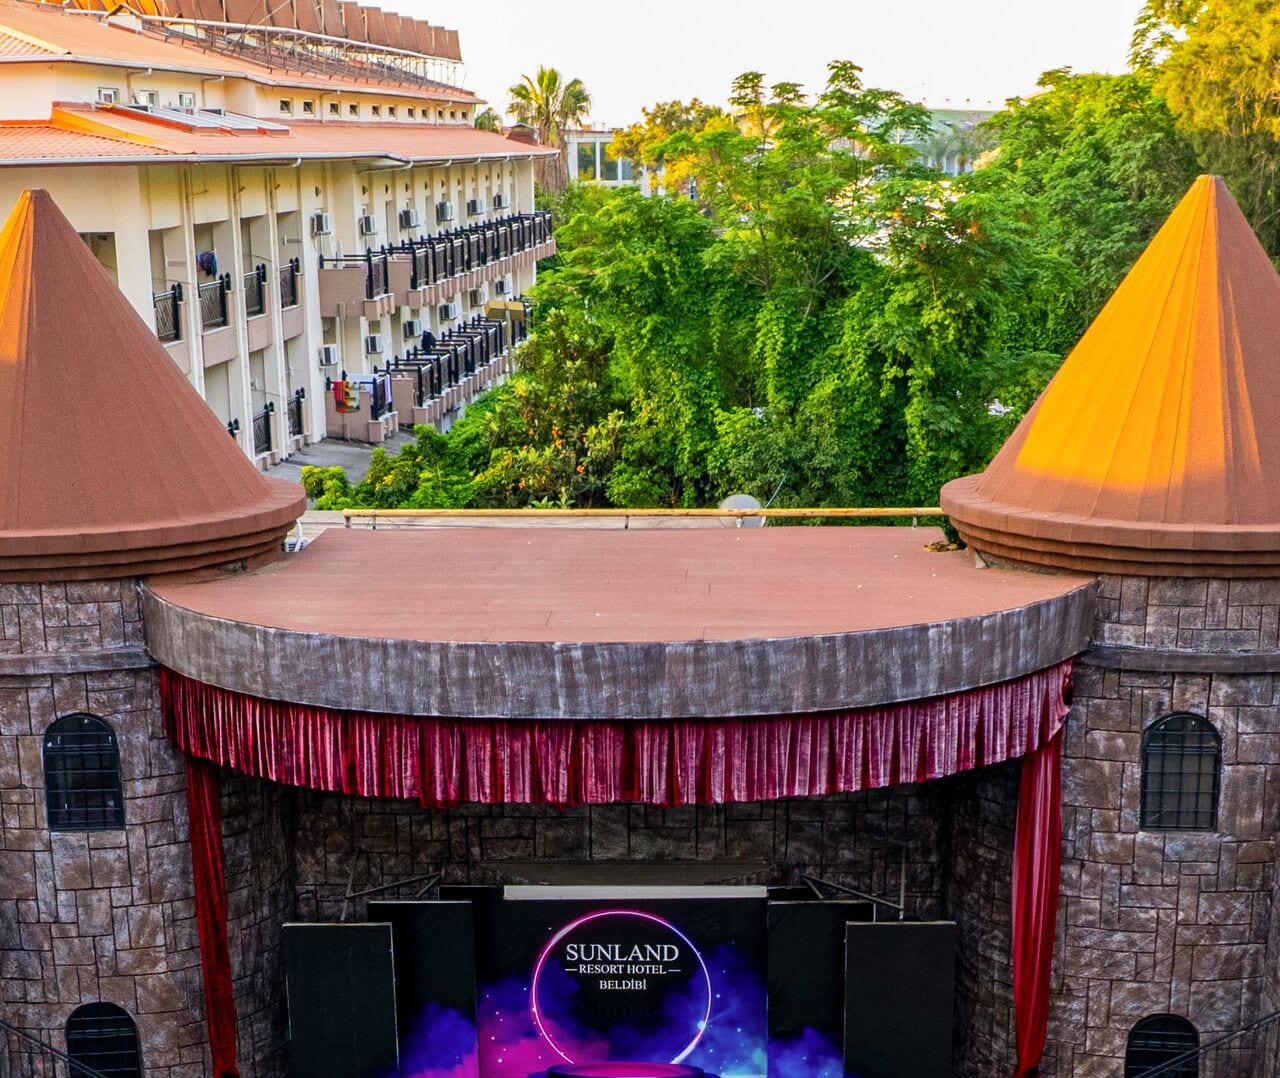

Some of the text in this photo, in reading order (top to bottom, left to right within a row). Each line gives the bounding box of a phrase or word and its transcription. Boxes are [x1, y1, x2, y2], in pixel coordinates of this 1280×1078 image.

[566, 944, 679, 960] SUNLAND
[579, 964, 668, 975] RESORT HOTEL
